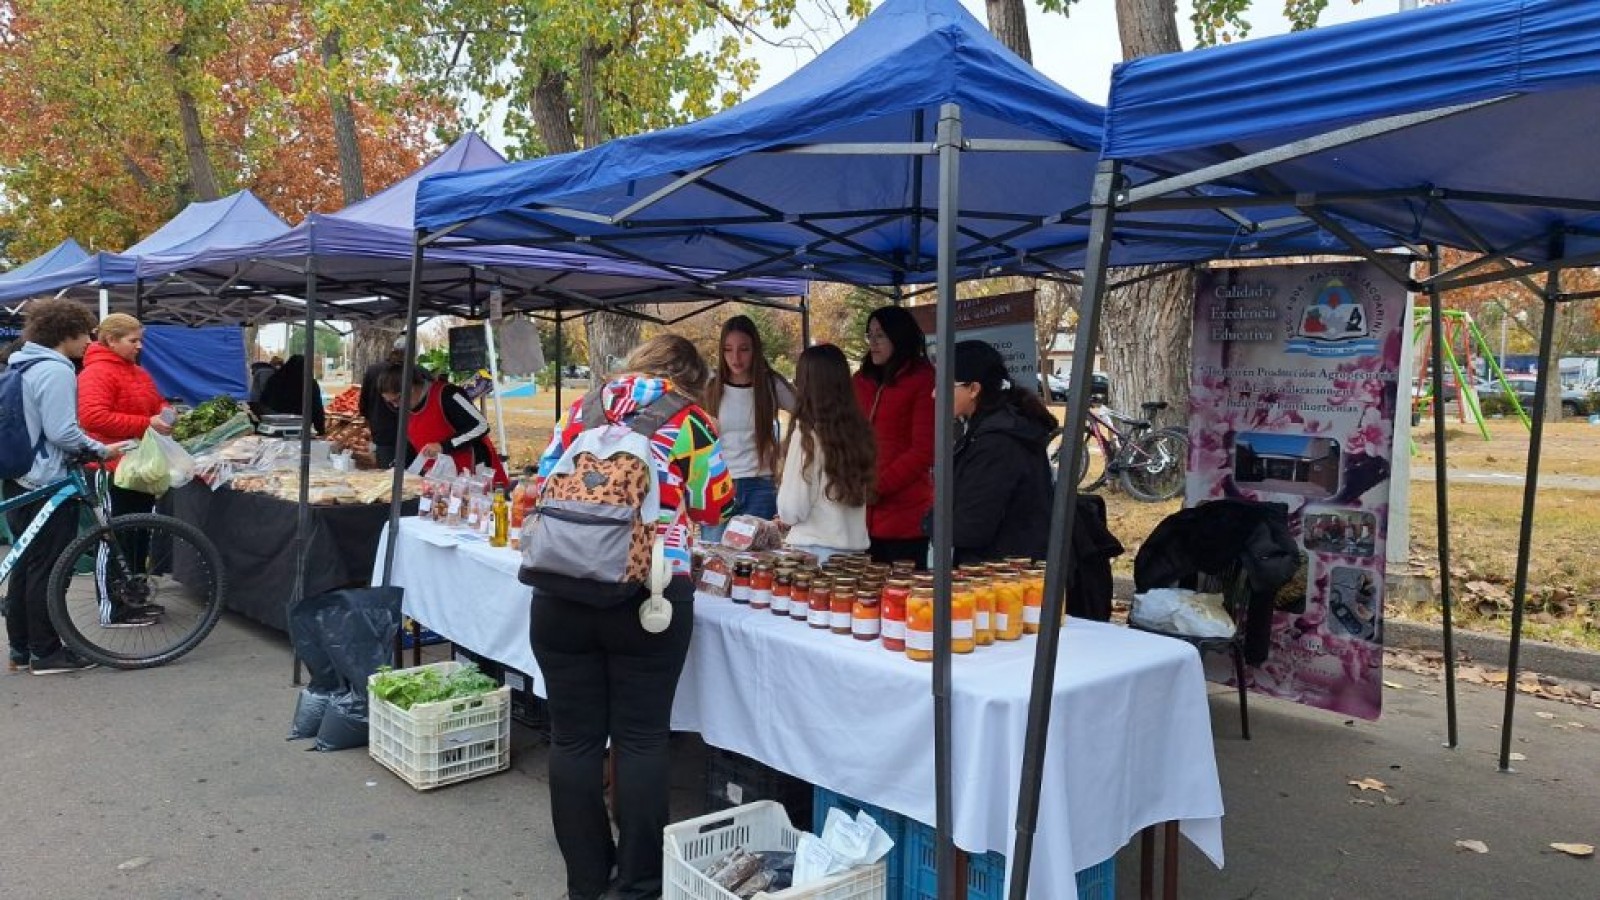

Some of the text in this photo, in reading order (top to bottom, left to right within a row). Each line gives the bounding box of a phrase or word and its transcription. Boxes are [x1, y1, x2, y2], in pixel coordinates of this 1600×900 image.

[1215, 283, 1263, 298] Calidad
[1211, 306, 1276, 319] Excelencia
[1212, 327, 1273, 341] Educativa
